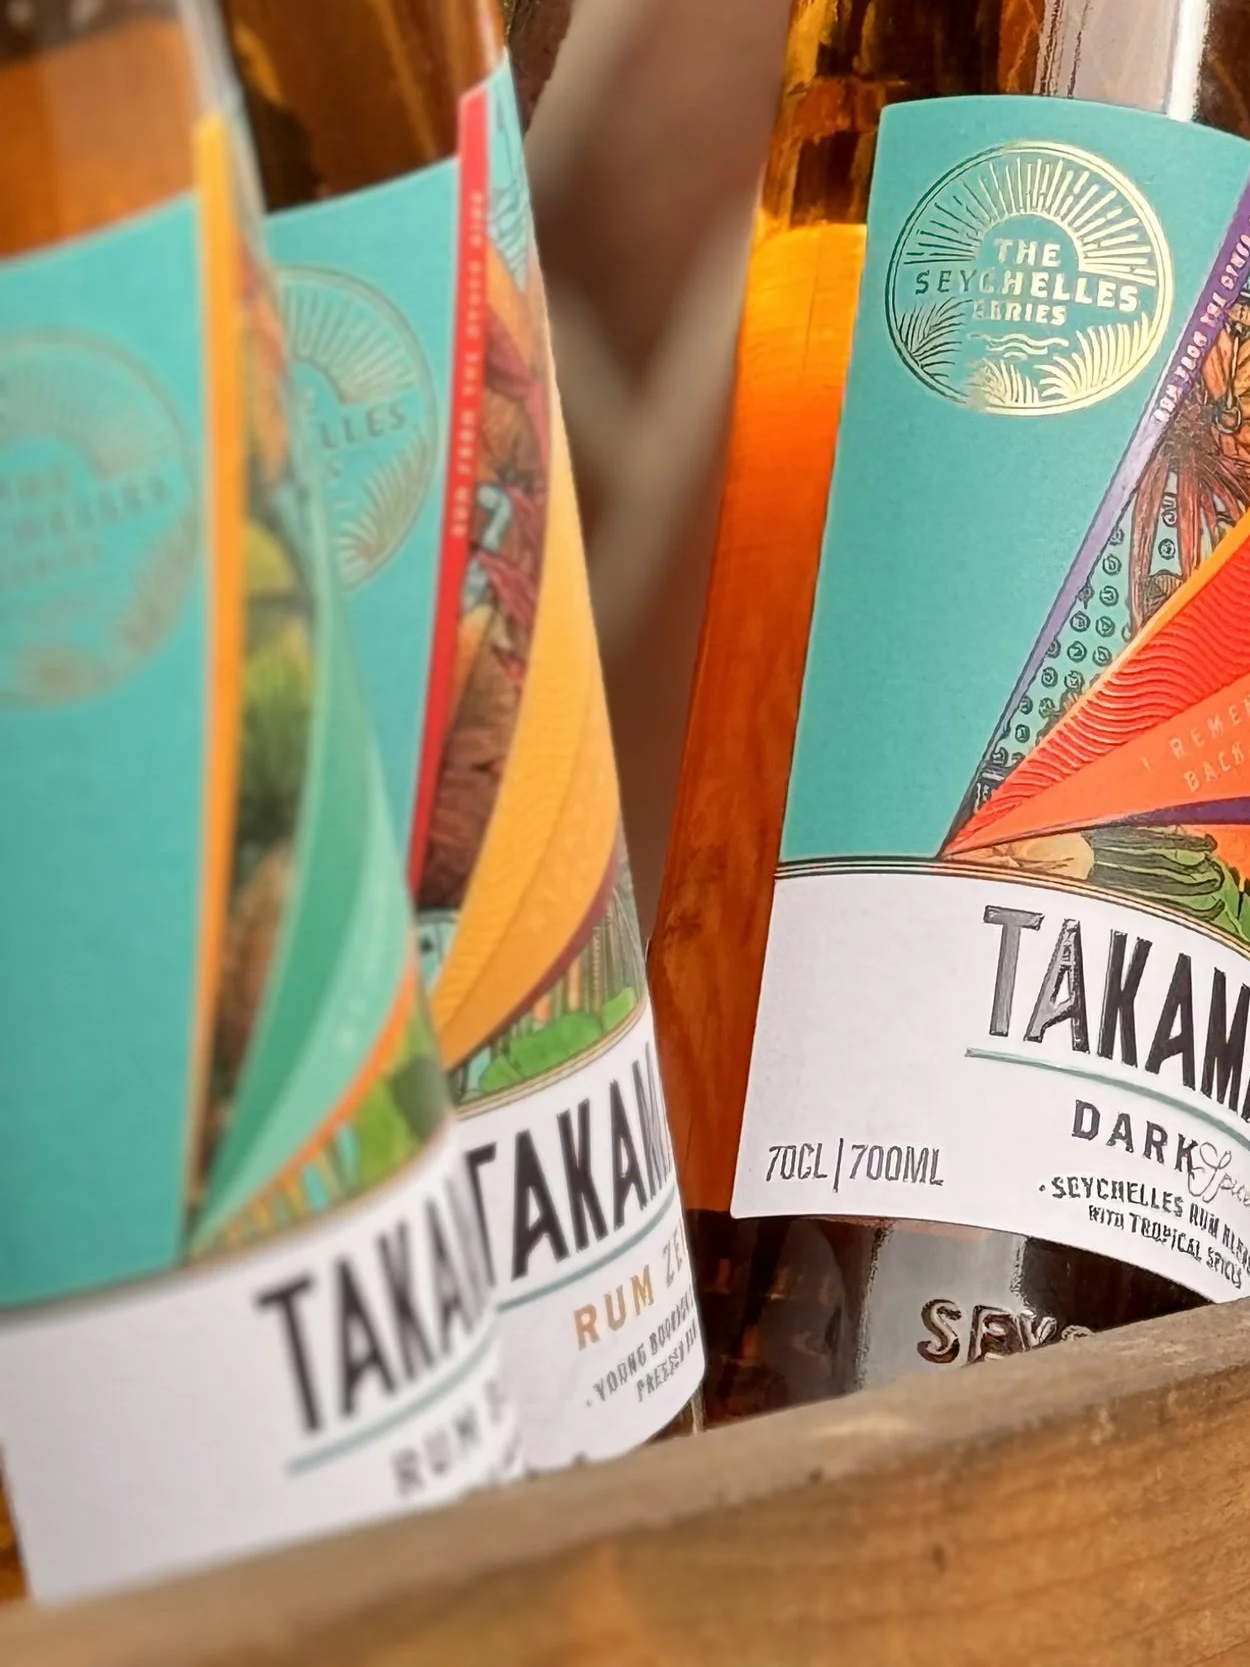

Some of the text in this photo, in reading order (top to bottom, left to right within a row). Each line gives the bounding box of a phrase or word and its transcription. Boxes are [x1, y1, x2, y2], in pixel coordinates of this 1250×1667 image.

[994, 237, 1062, 268] THE
[915, 268, 1139, 313] SEYCHELLES
[1071, 1098, 1198, 1177] DARK
[1051, 1175, 1184, 1219] SEYCHELLES
[1189, 1201, 1220, 1240] RUM
[1088, 1202, 1125, 1231] WITH
[1129, 1211, 1203, 1262] TROPICAL
[573, 1263, 655, 1351] RUM
[593, 1340, 647, 1402] YOUNG
